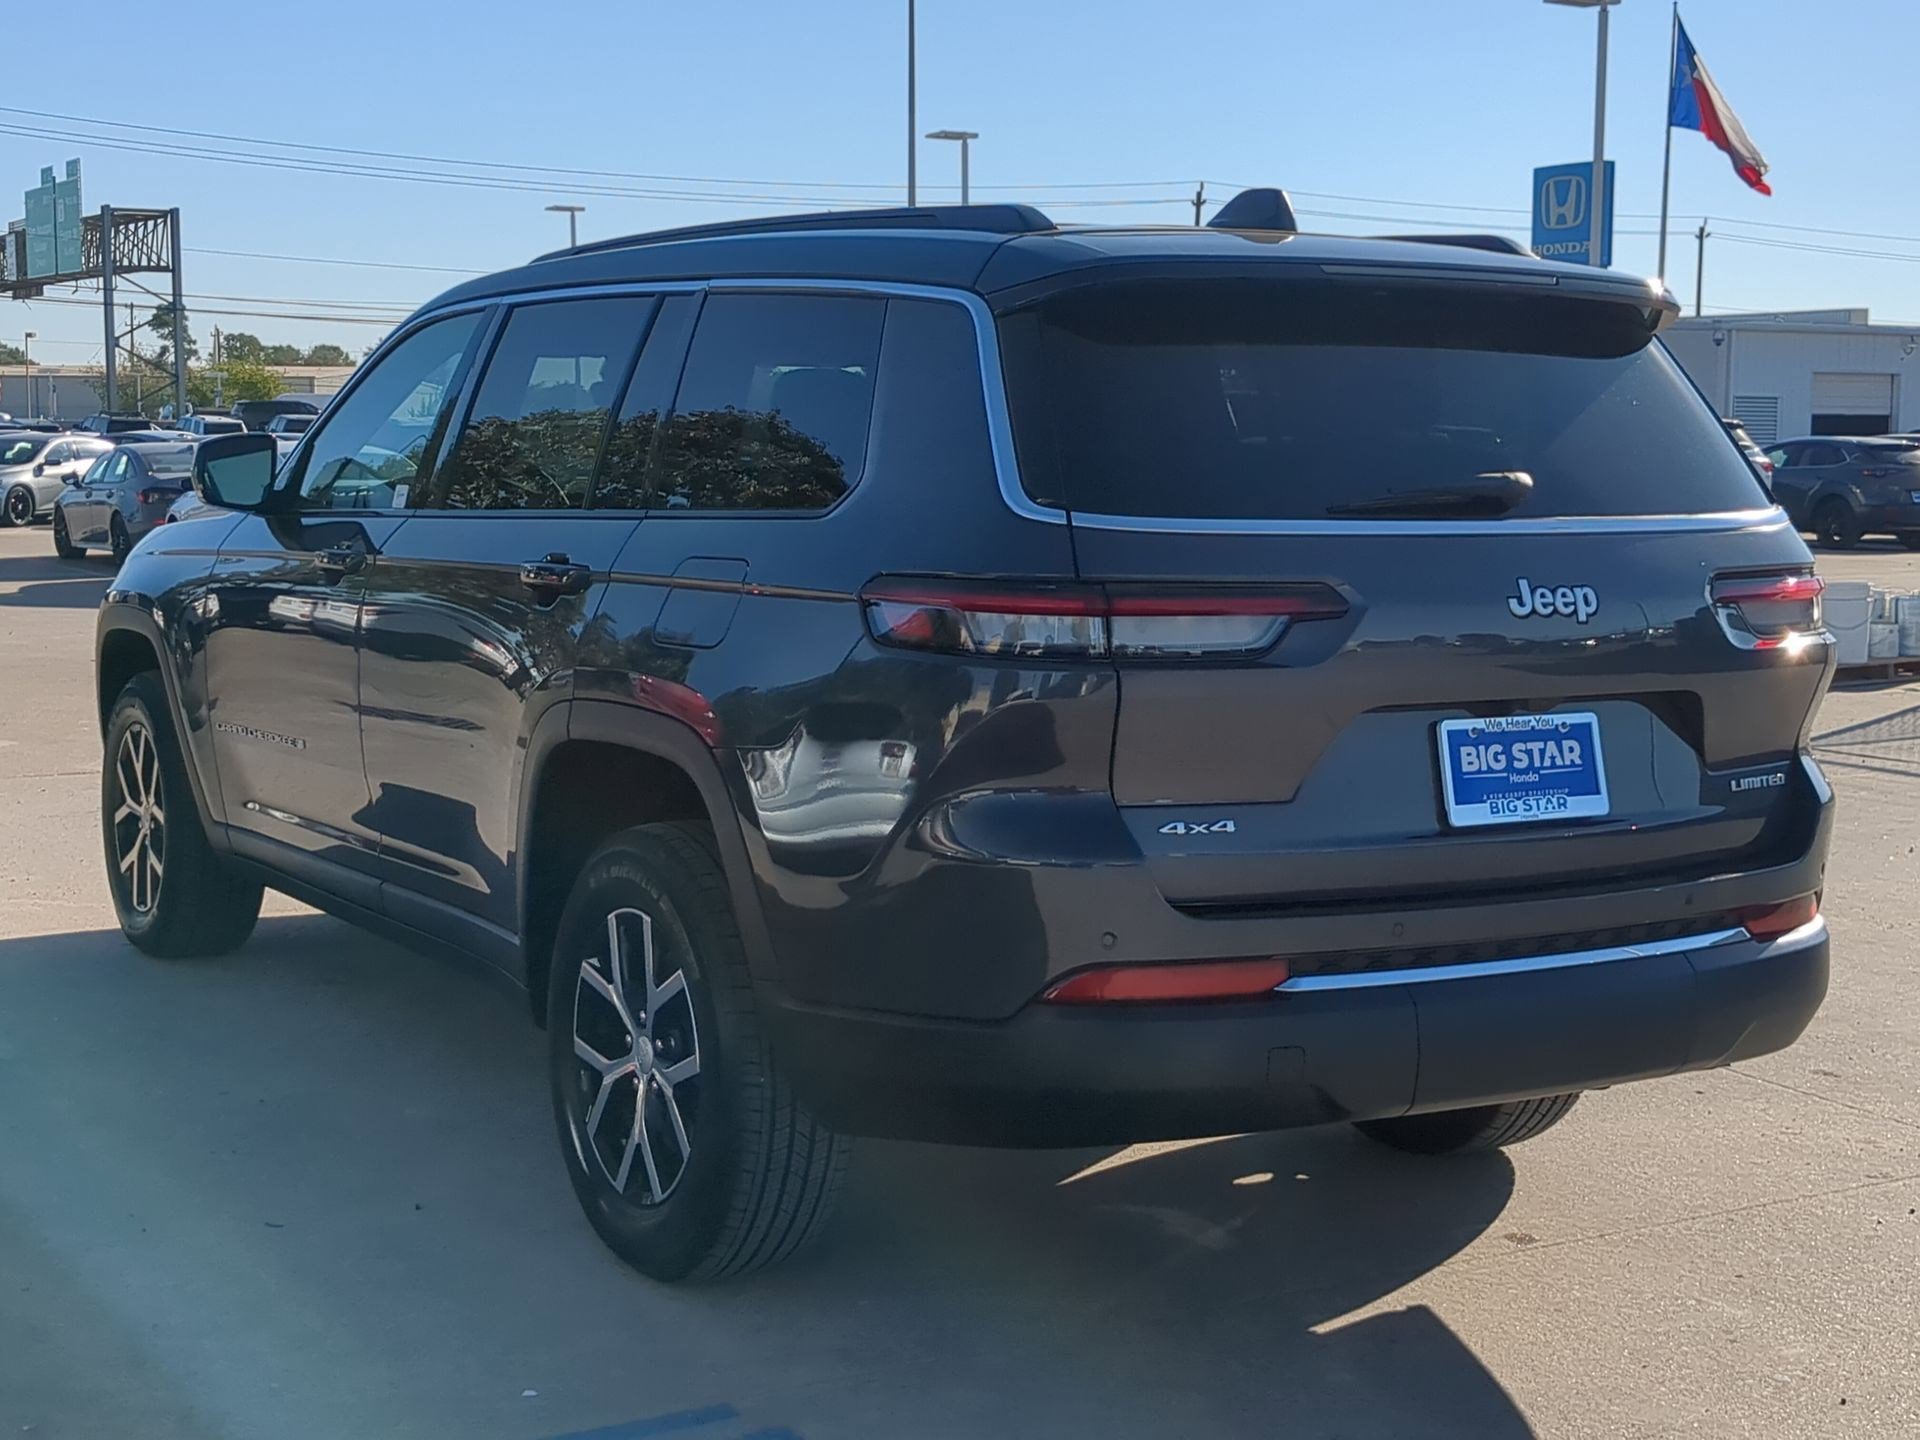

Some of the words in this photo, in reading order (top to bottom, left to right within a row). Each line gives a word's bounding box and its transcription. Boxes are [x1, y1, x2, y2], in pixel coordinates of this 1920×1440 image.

[1507, 577, 1599, 624] Jeep
[1484, 718, 1503, 731] We
[1504, 718, 1532, 730] Hear
[1533, 716, 1555, 728] You
[1460, 744, 1507, 773] BIG
[1512, 739, 1582, 769] STAR
[1509, 771, 1539, 784] Honda
[1730, 772, 1785, 792] LIMITED
[1489, 800, 1518, 815] BIG
[1522, 796, 1568, 812] STAR
[1159, 820, 1236, 834] 4x4
